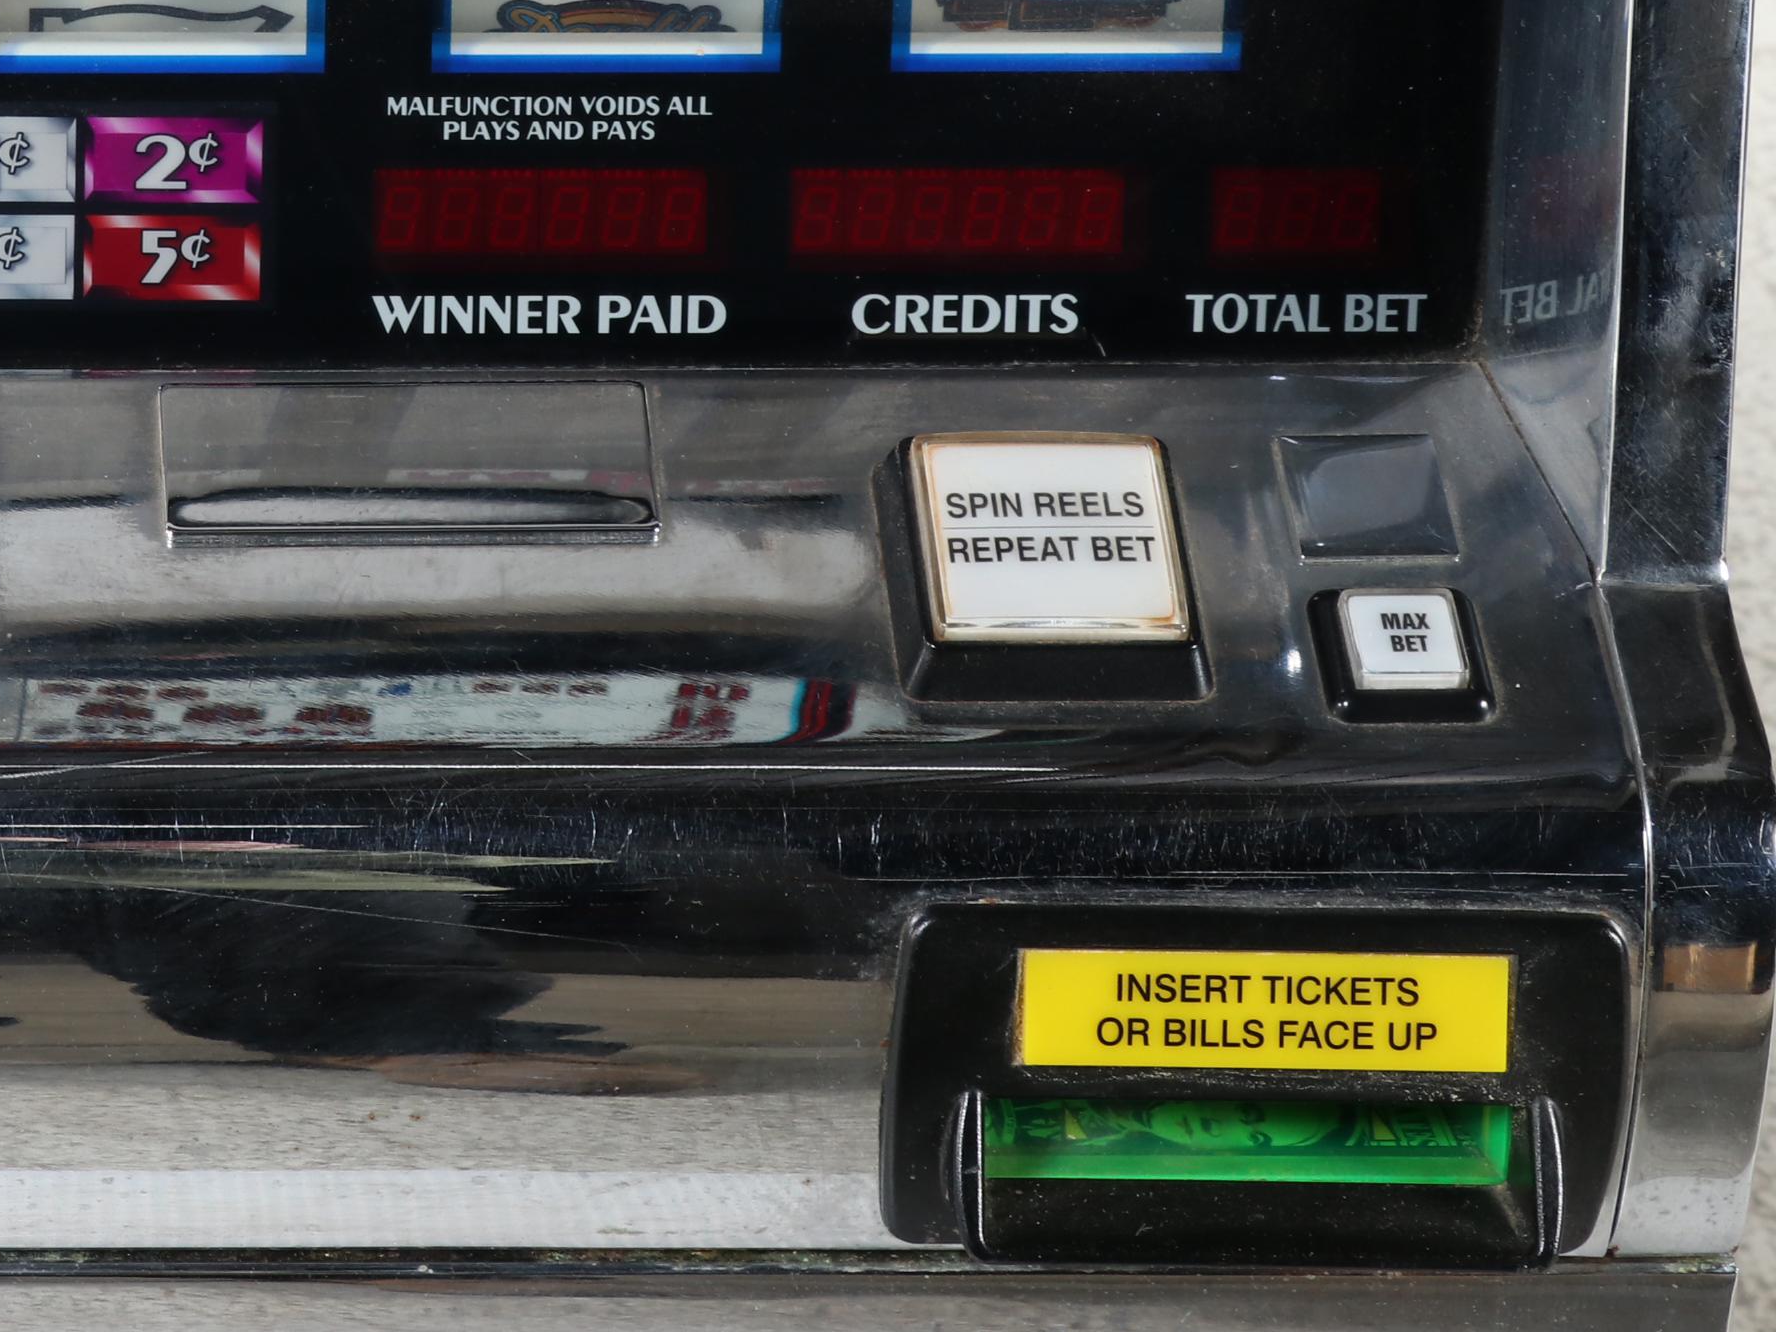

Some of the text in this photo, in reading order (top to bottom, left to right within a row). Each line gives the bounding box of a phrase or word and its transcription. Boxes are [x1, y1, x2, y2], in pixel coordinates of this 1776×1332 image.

[387, 96, 713, 116] MALFUNCTION VOIDS ALL
[443, 120, 655, 141] PLAYS AND PAYS
[135, 132, 219, 190] 2¢
[141, 228, 211, 284] 5¢
[372, 294, 727, 335] WINNER PAID
[851, 293, 1079, 336] CREDITS
[1185, 293, 1428, 334] TOTAL BET
[946, 491, 1144, 519] SPIN REELS
[948, 537, 1156, 564] REPEAT BET
[1381, 612, 1431, 631] MAX
[1390, 635, 1428, 653] BET
[1116, 973, 1420, 1007] INSERT TICKETS
[1096, 1017, 1438, 1052] OR BILLS FACE UP
